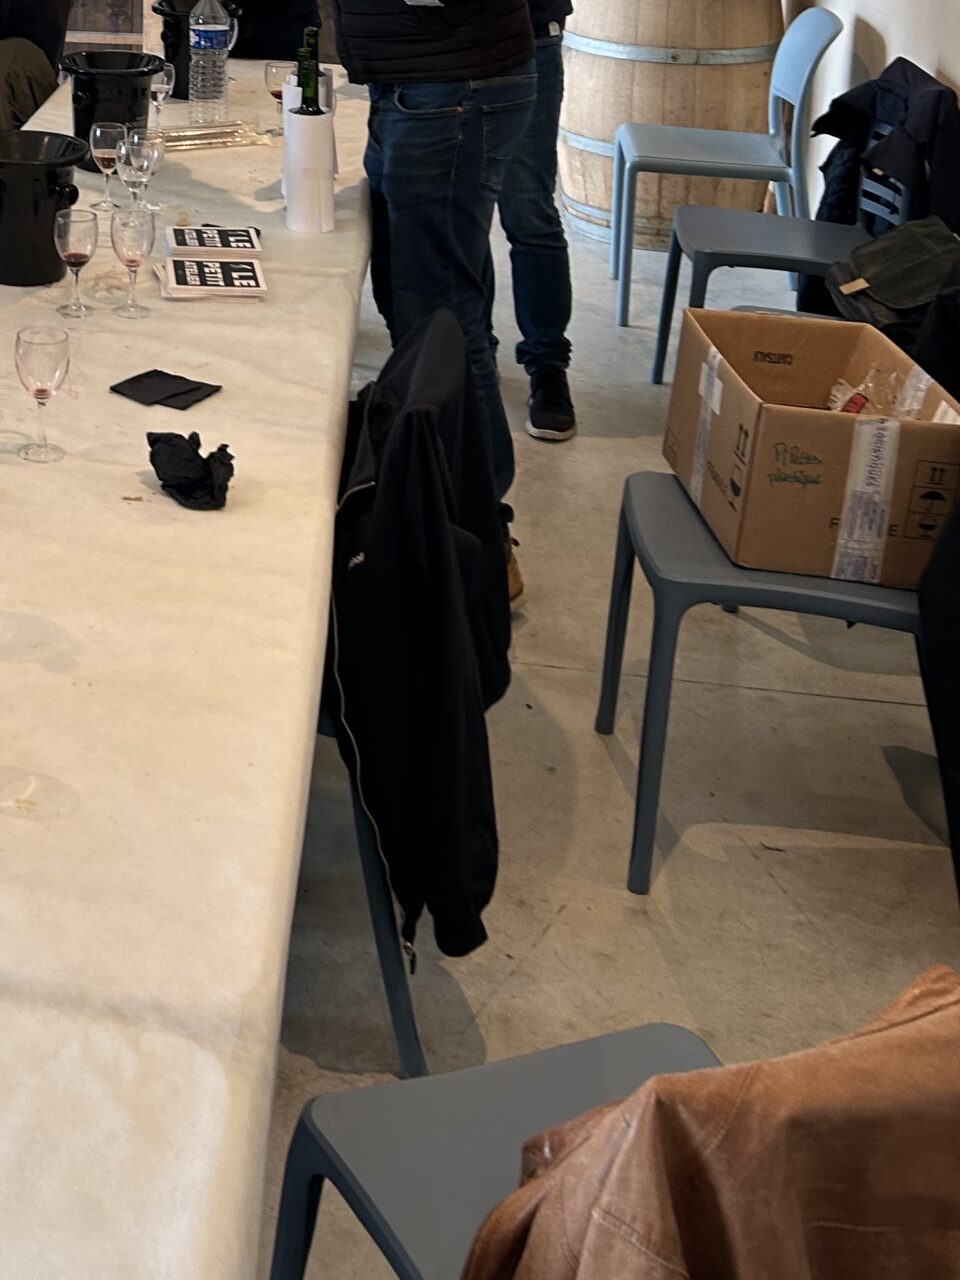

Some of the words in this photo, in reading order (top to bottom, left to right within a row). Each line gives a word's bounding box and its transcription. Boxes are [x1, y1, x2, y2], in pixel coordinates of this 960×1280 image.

[184, 229, 200, 247] ATELIER
[201, 229, 222, 247] PETIT
[228, 236, 252, 248] LE
[184, 260, 201, 286] ATELIER
[202, 262, 225, 286] PETIT
[231, 272, 257, 287] LE
